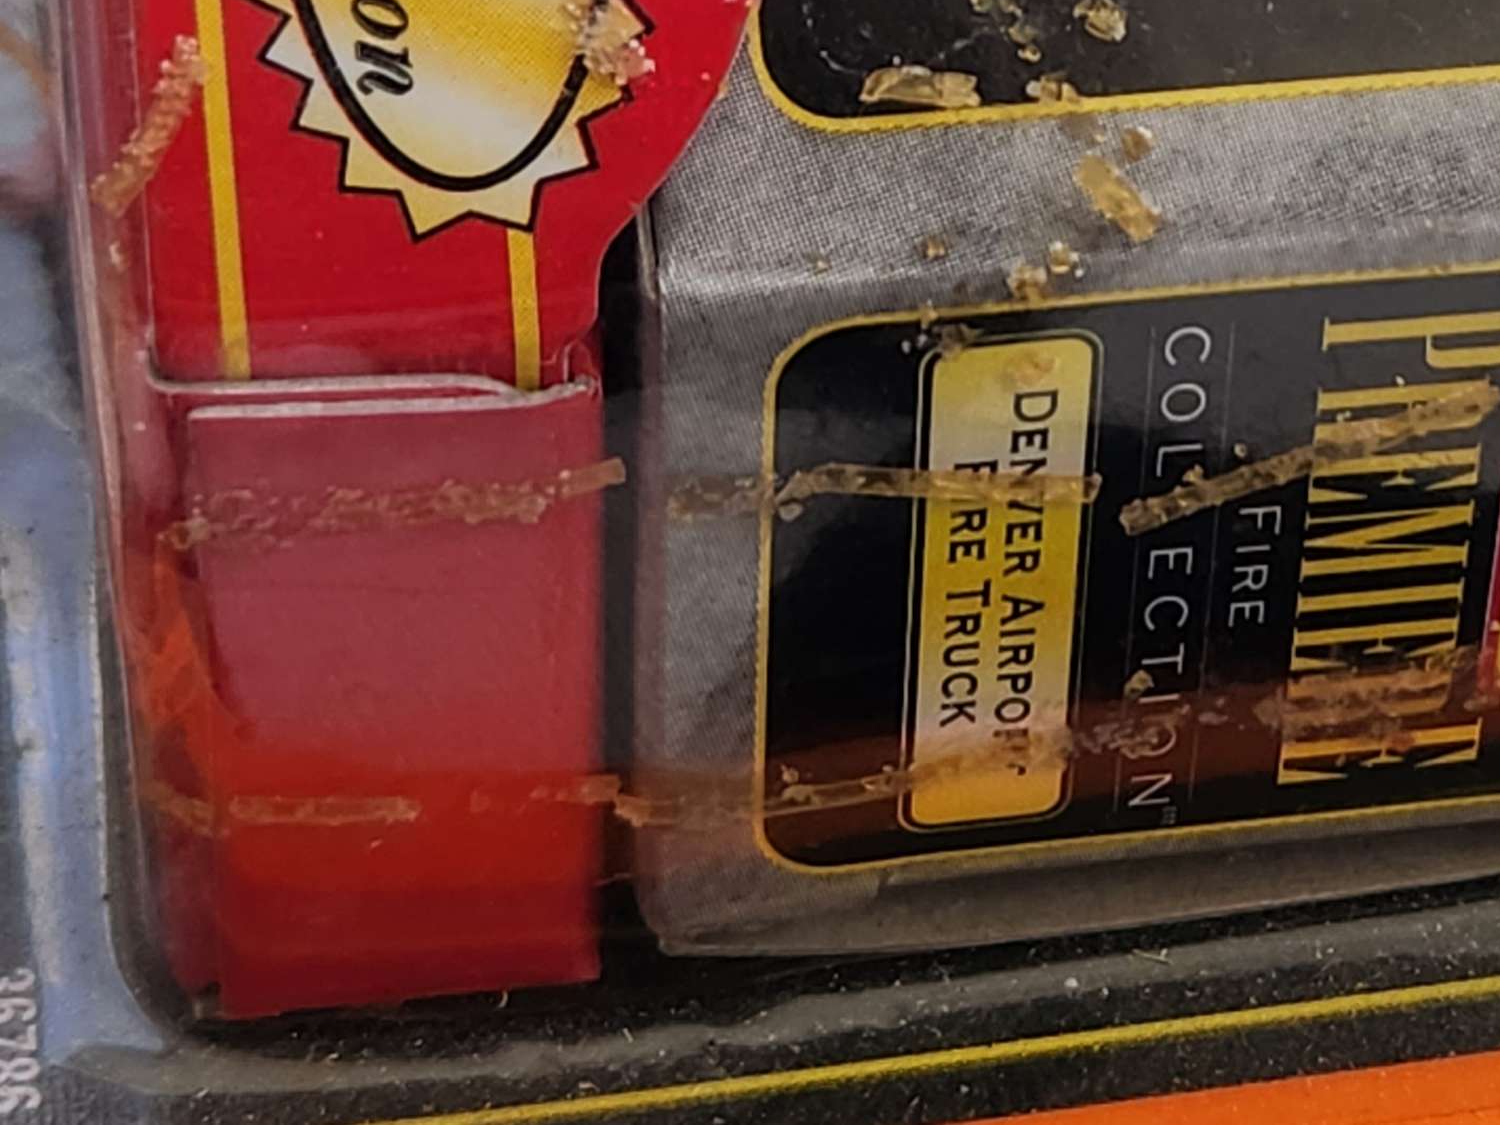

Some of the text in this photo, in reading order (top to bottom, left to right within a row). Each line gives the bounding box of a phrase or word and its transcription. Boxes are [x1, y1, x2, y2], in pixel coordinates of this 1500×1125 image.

[938, 459, 999, 727] FRE TRUCK
[1129, 326, 1211, 811] COLECTION
[1227, 503, 1282, 628] FIRE
